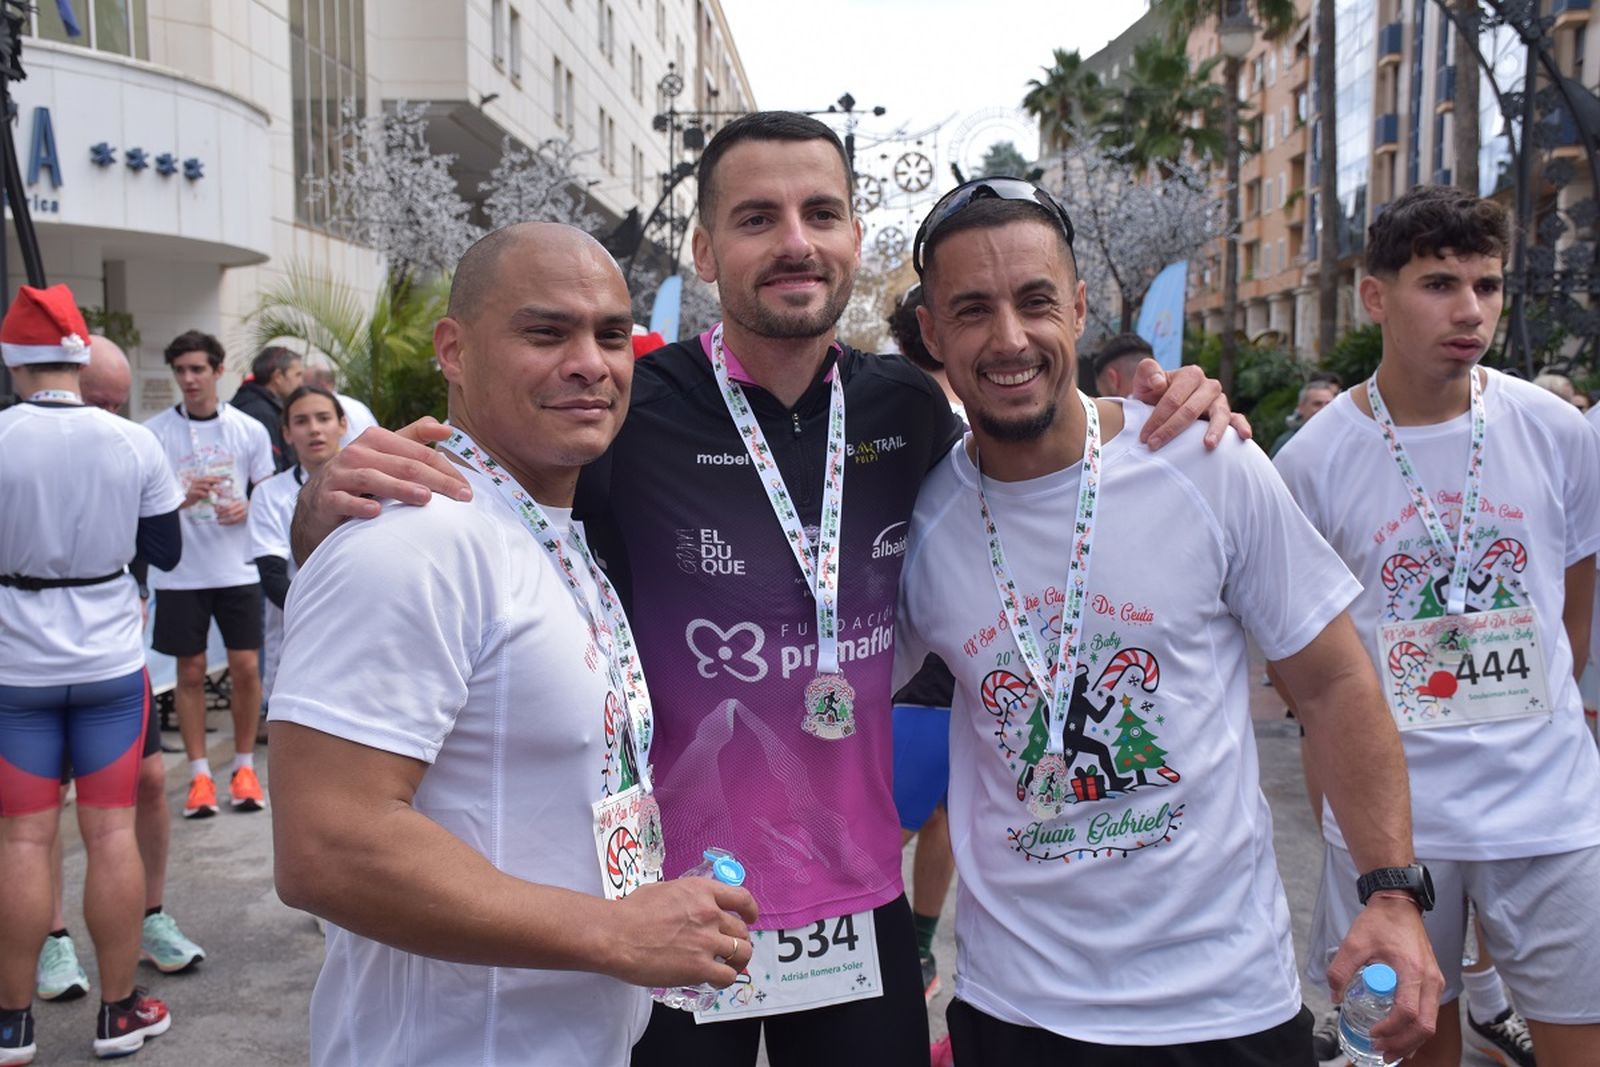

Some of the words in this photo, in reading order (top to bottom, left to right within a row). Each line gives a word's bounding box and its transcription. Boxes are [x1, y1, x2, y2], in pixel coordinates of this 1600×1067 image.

[700, 528, 726, 544] EL
[701, 545, 732, 560] DU
[701, 560, 747, 576] QUE
[1091, 594, 1116, 615] De
[1121, 602, 1154, 622] Ceuta
[1090, 631, 1122, 651] Baby
[1456, 648, 1531, 685] 444
[1020, 821, 1076, 849] Juan
[1086, 802, 1170, 845] Gabriel
[778, 914, 859, 963] 534
[781, 971, 809, 983] Adrián
[810, 965, 841, 978] Romera
[842, 961, 864, 972] Soler
